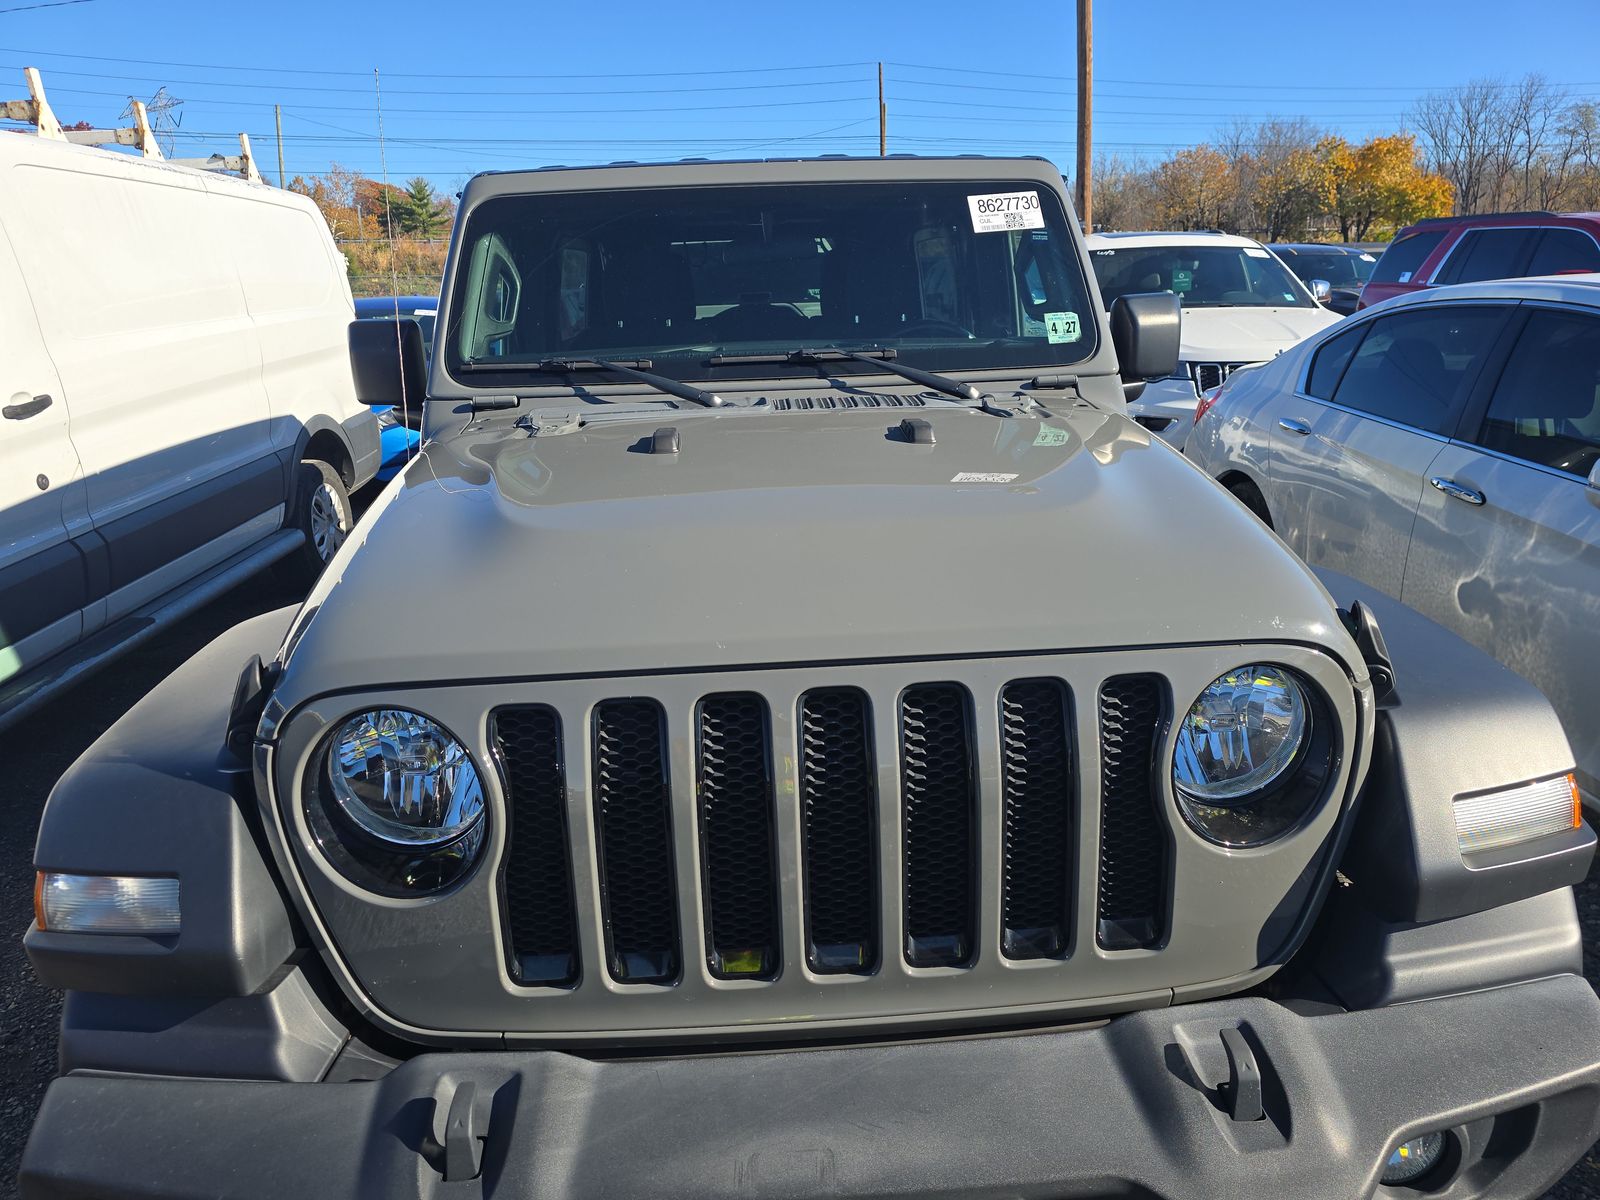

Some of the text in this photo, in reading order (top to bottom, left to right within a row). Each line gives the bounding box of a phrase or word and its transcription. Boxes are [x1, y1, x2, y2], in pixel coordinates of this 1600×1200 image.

[977, 195, 1039, 213] 8627730
[1051, 321, 1076, 335] 4 27
